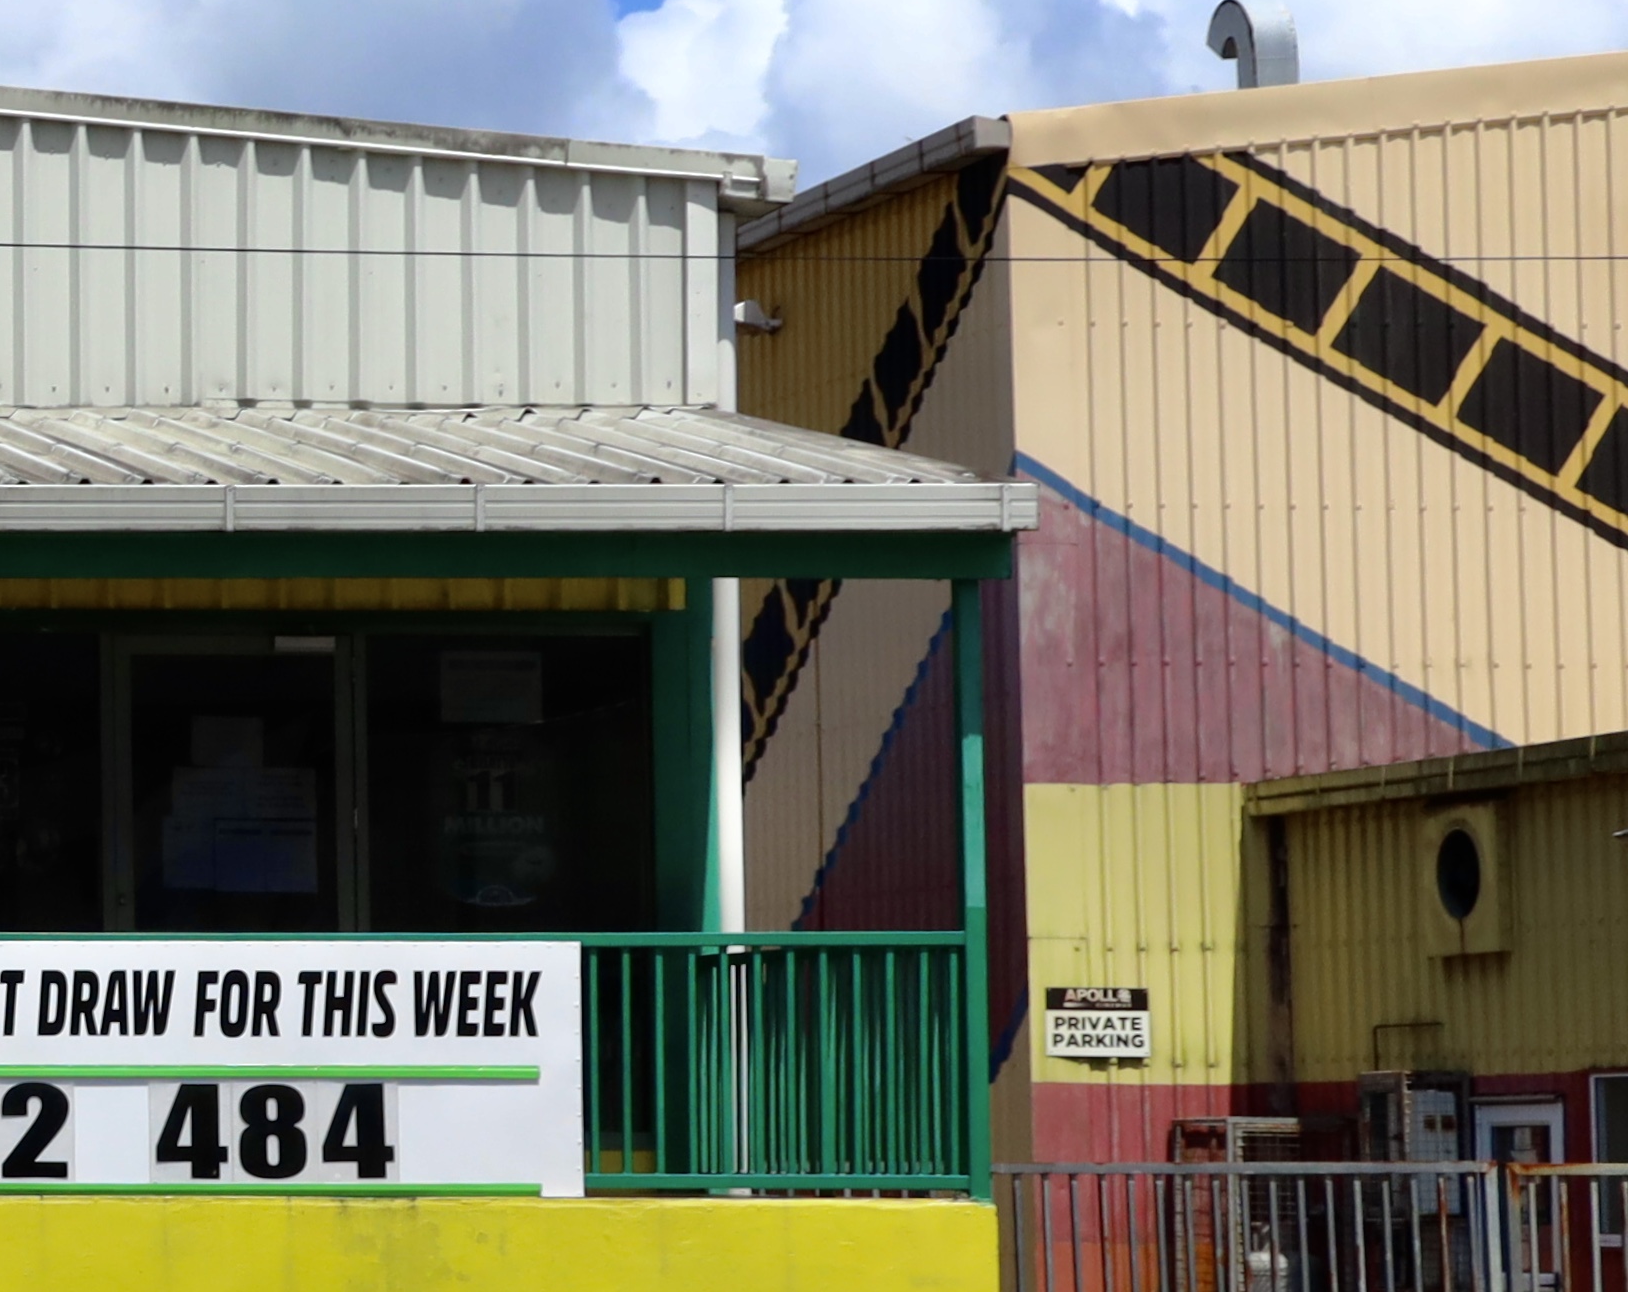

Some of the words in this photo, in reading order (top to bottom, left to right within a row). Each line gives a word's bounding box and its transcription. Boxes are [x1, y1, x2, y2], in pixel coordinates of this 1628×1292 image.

[37, 969, 177, 1037] DRAW
[194, 969, 282, 1038] FOR
[297, 969, 397, 1038] THIS
[413, 970, 543, 1038] WEEK
[1054, 1016, 1143, 1031] PRIVATE
[1052, 1033, 1145, 1048] PARKING
[156, 1082, 396, 1180] 484
